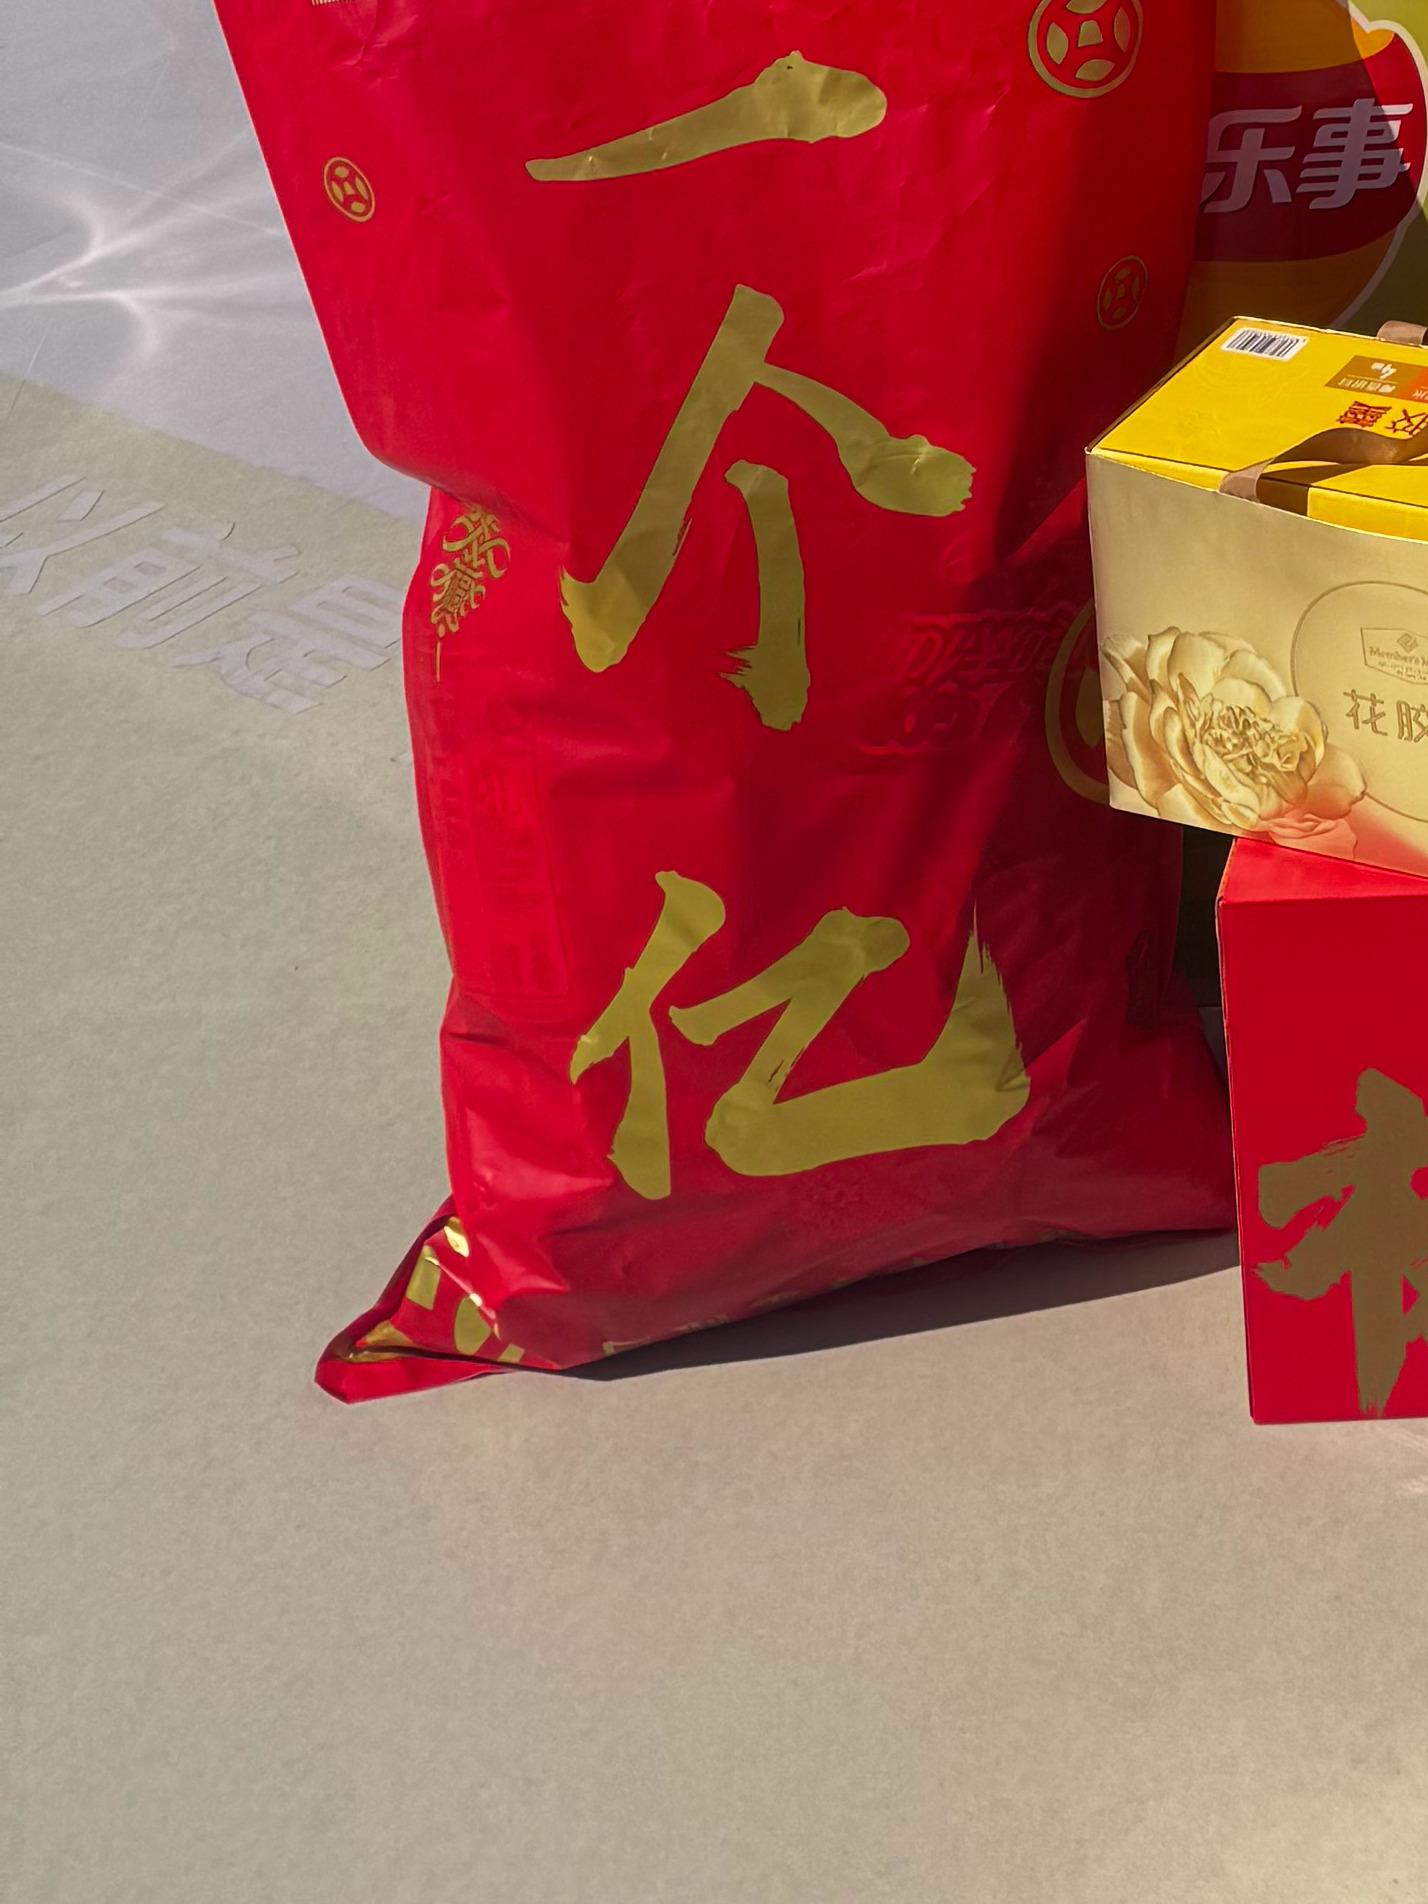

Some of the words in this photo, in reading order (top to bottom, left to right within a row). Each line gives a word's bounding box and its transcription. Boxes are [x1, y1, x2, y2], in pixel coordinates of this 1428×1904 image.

[1201, 97, 1417, 214] 乐事
[526, 49, 1030, 1201] 一个亿
